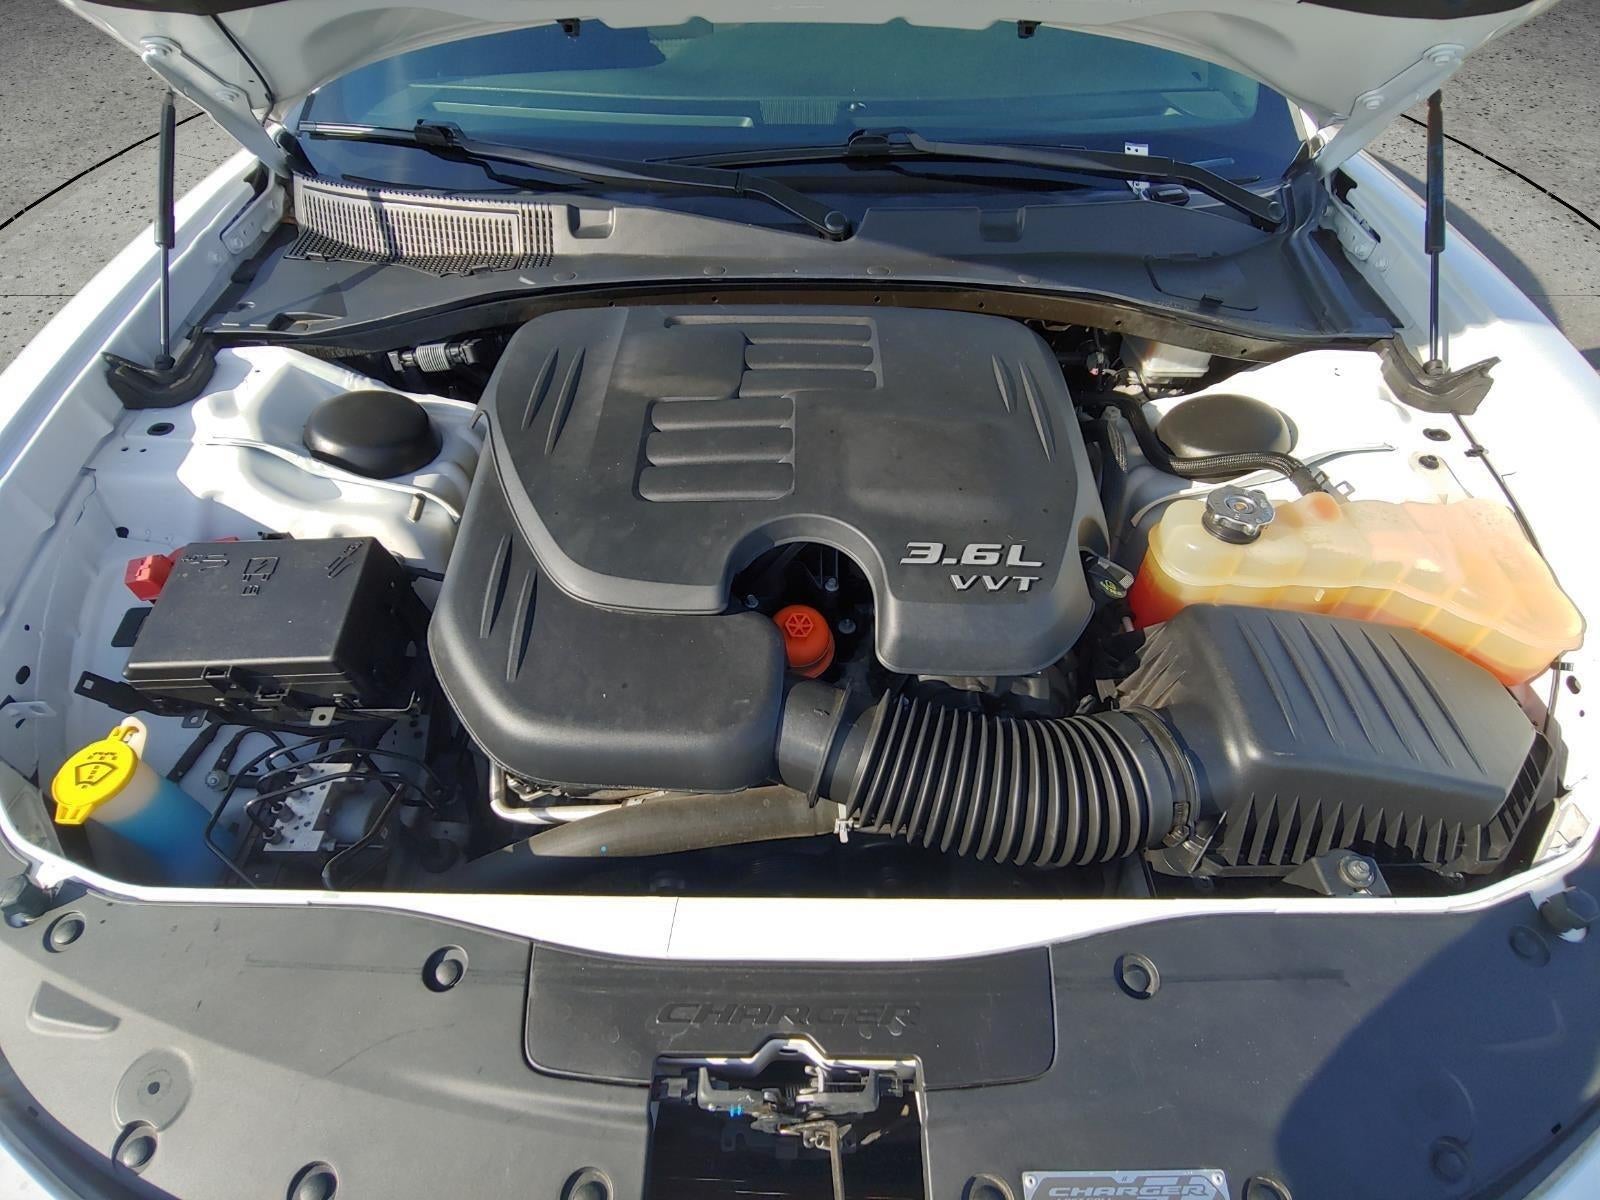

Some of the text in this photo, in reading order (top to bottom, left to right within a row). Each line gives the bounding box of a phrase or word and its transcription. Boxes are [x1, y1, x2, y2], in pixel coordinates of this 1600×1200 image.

[900, 542, 1043, 567] 3.6L
[950, 574, 1040, 592] VVT
[656, 1002, 919, 1026] CHARGER
[1049, 1185, 1207, 1197] CHARGER
